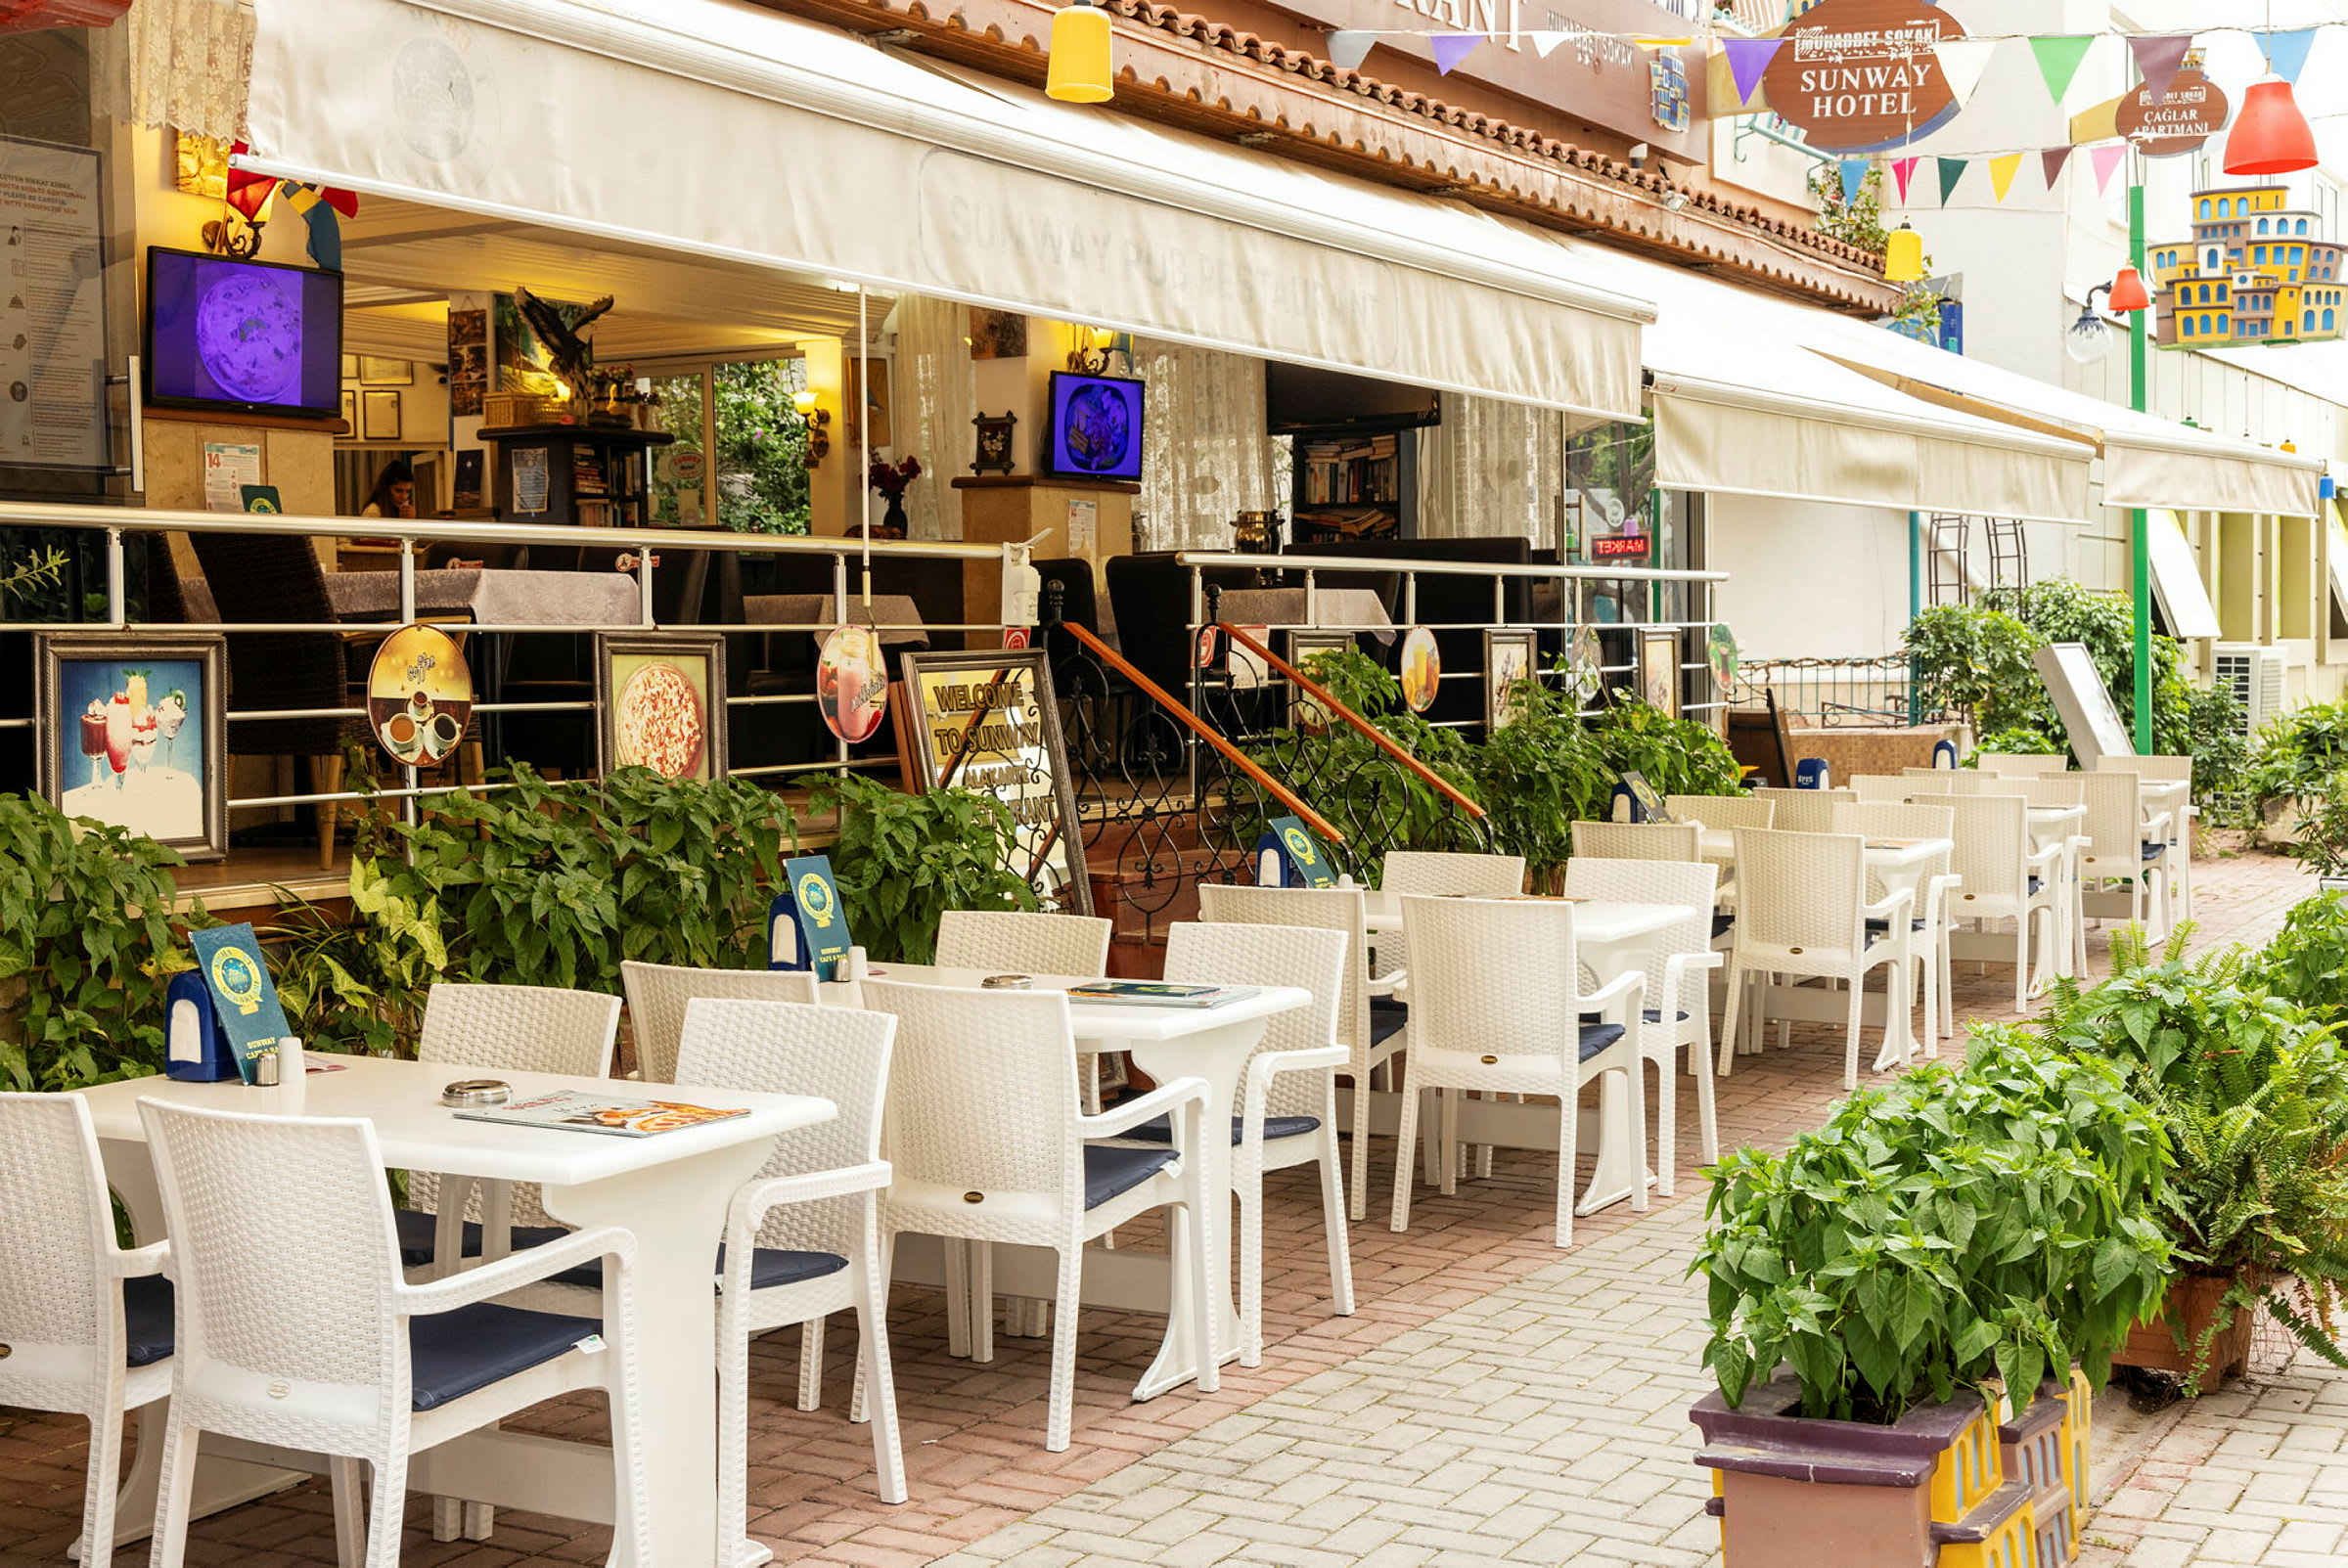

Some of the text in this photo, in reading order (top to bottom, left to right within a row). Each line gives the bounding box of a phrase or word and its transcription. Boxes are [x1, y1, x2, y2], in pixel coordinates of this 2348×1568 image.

[1800, 64, 1931, 93] SUNWAY
[1812, 92, 1918, 118] HOTEL
[2144, 108, 2198, 125] ÇAĞLAR
[207, 452, 221, 468] 14
[933, 681, 1024, 713] WELCOME
[934, 722, 1040, 756] TO SUNWAY
